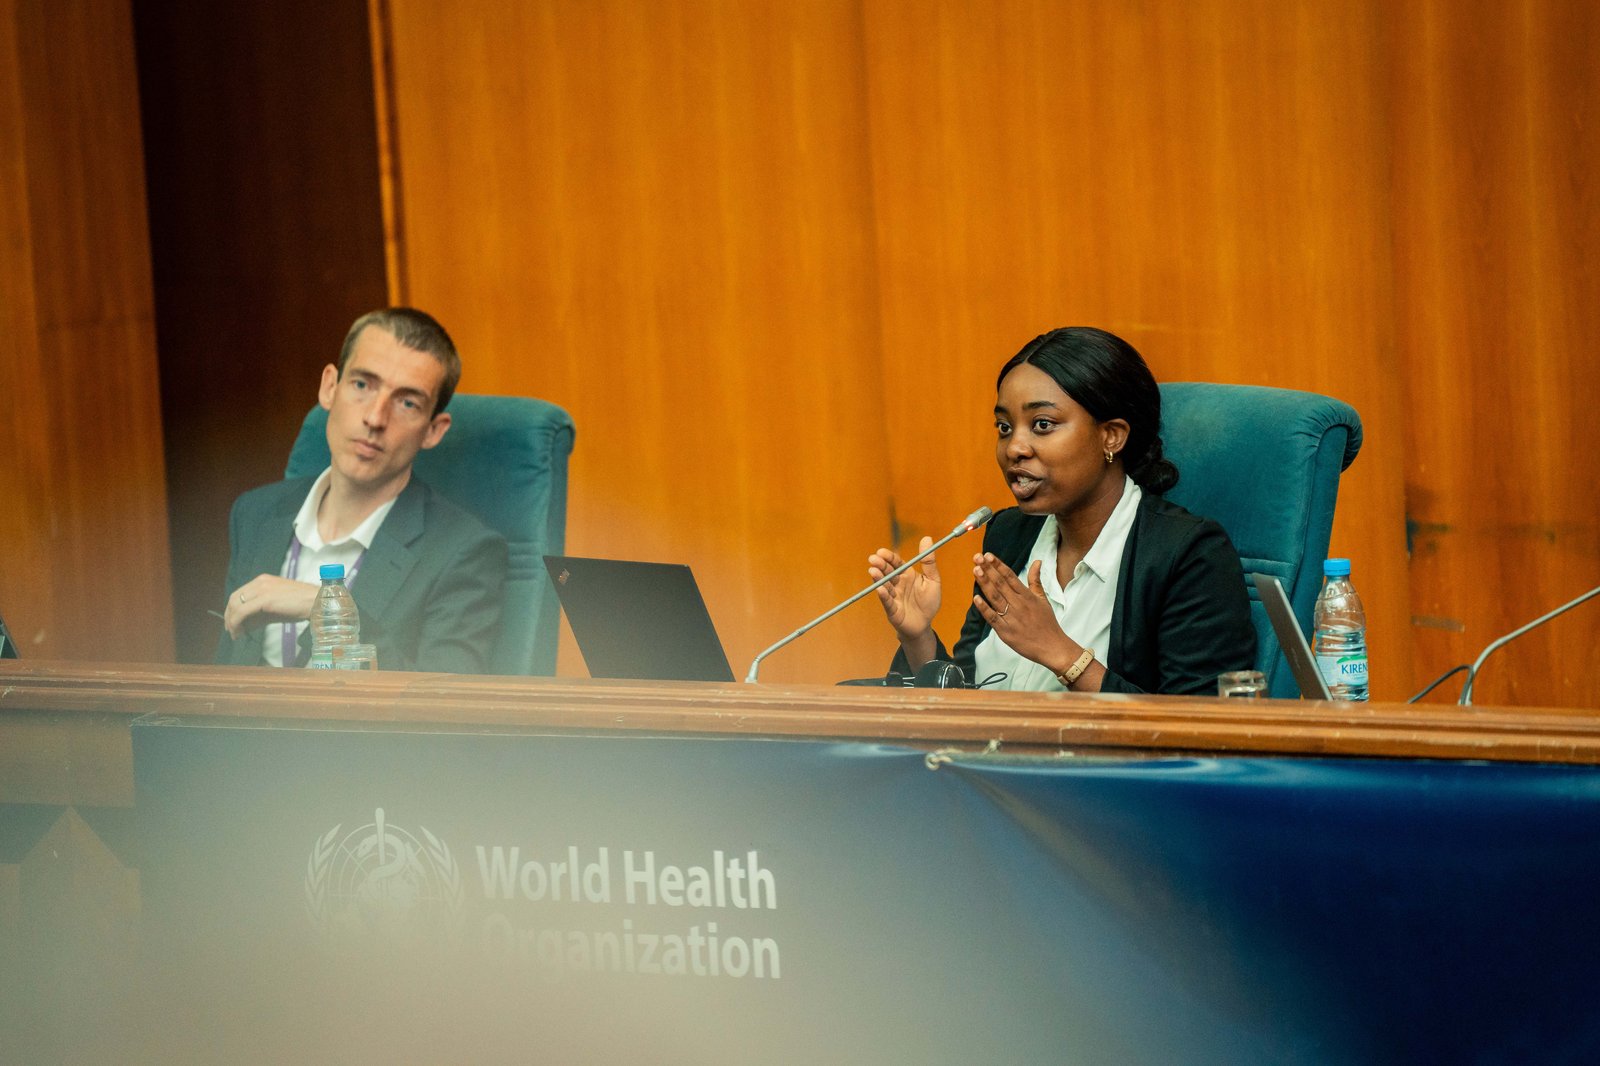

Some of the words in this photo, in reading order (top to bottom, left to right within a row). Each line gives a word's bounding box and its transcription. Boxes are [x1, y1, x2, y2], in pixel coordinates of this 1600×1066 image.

[475, 845, 611, 904] World
[622, 850, 777, 910] Health
[483, 912, 781, 982] Organization
